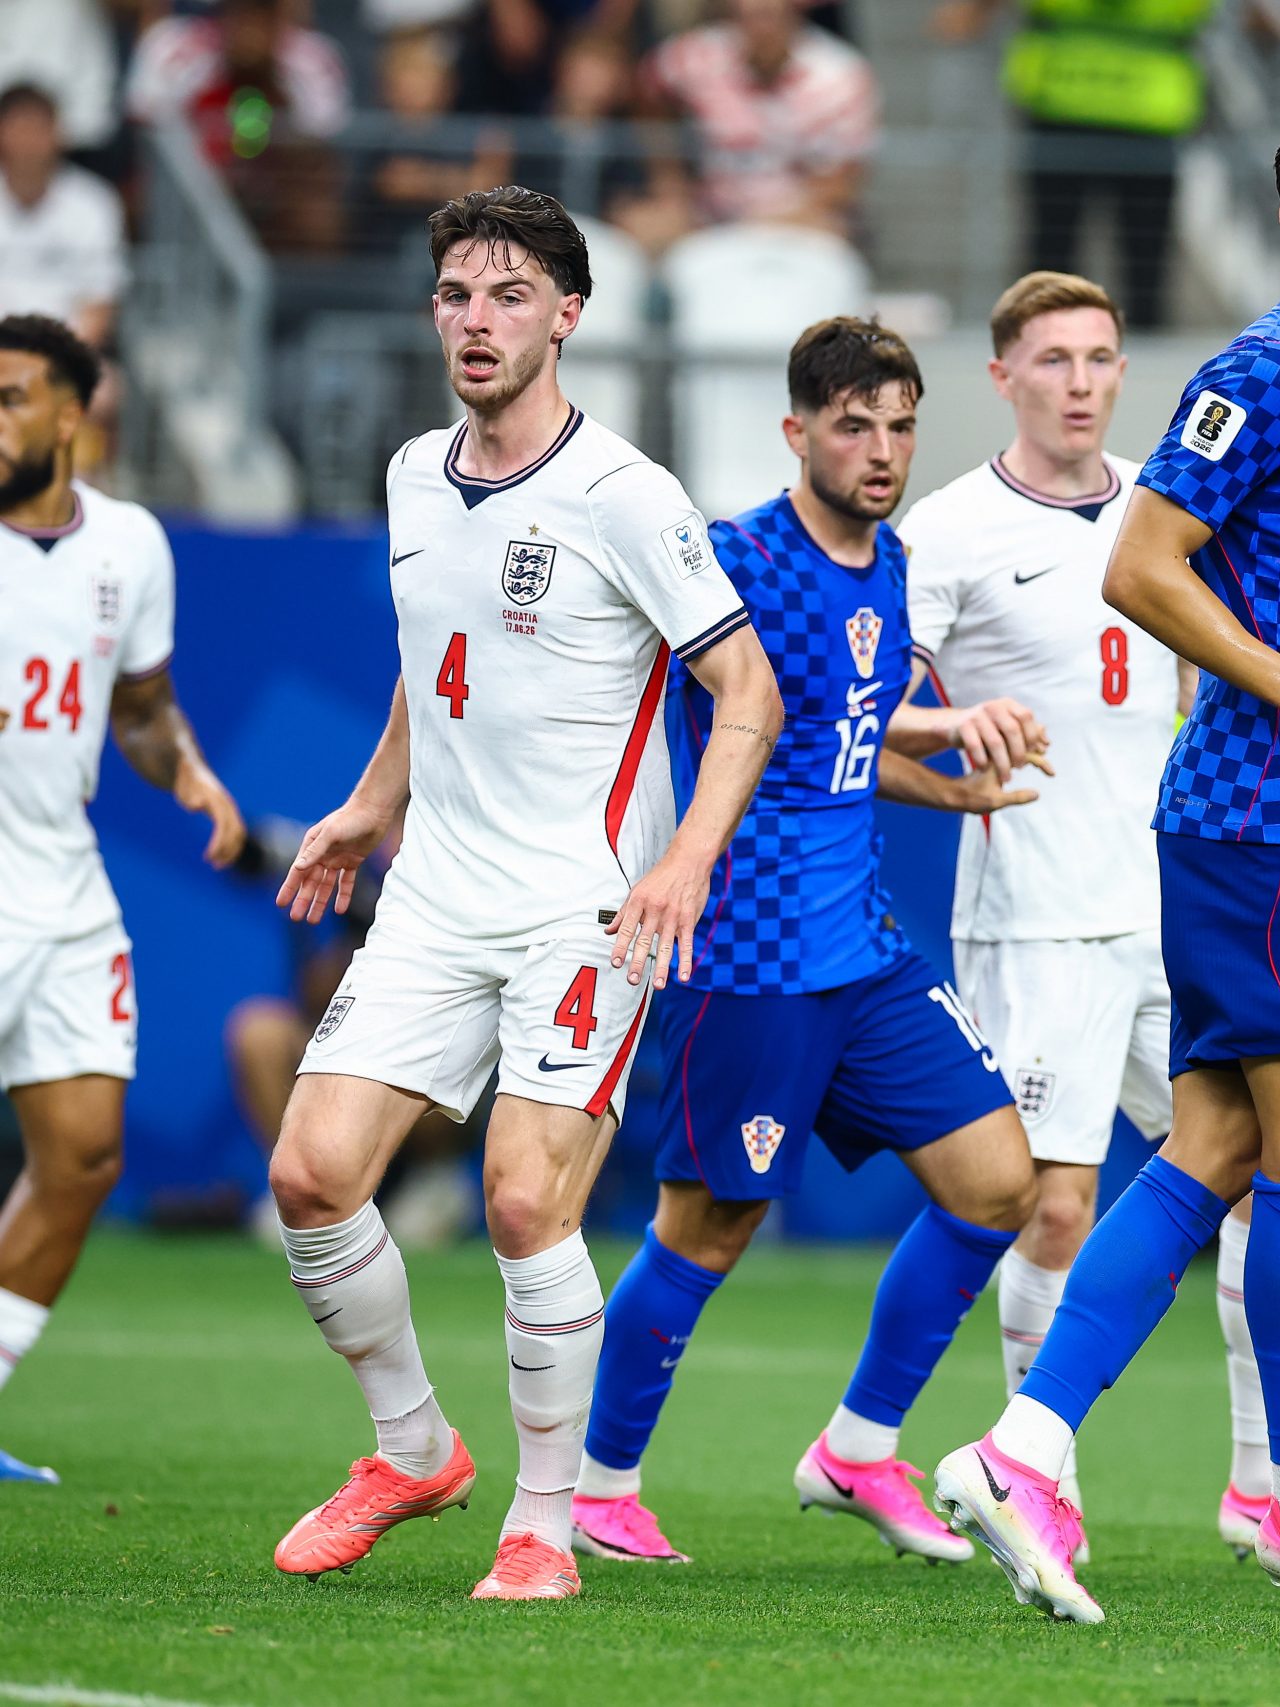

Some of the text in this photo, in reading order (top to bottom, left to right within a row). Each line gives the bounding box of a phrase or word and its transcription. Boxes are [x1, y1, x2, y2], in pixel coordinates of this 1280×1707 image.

[1190, 439, 1212, 454] 2026
[683, 549, 704, 567] PEACE
[502, 609, 538, 624] CROATIA
[505, 622, 536, 636] 17.06.26
[22, 656, 84, 734] 24
[436, 632, 469, 720] 4
[1100, 626, 1128, 706] 8
[829, 713, 880, 795] 16
[553, 965, 598, 1051] 4
